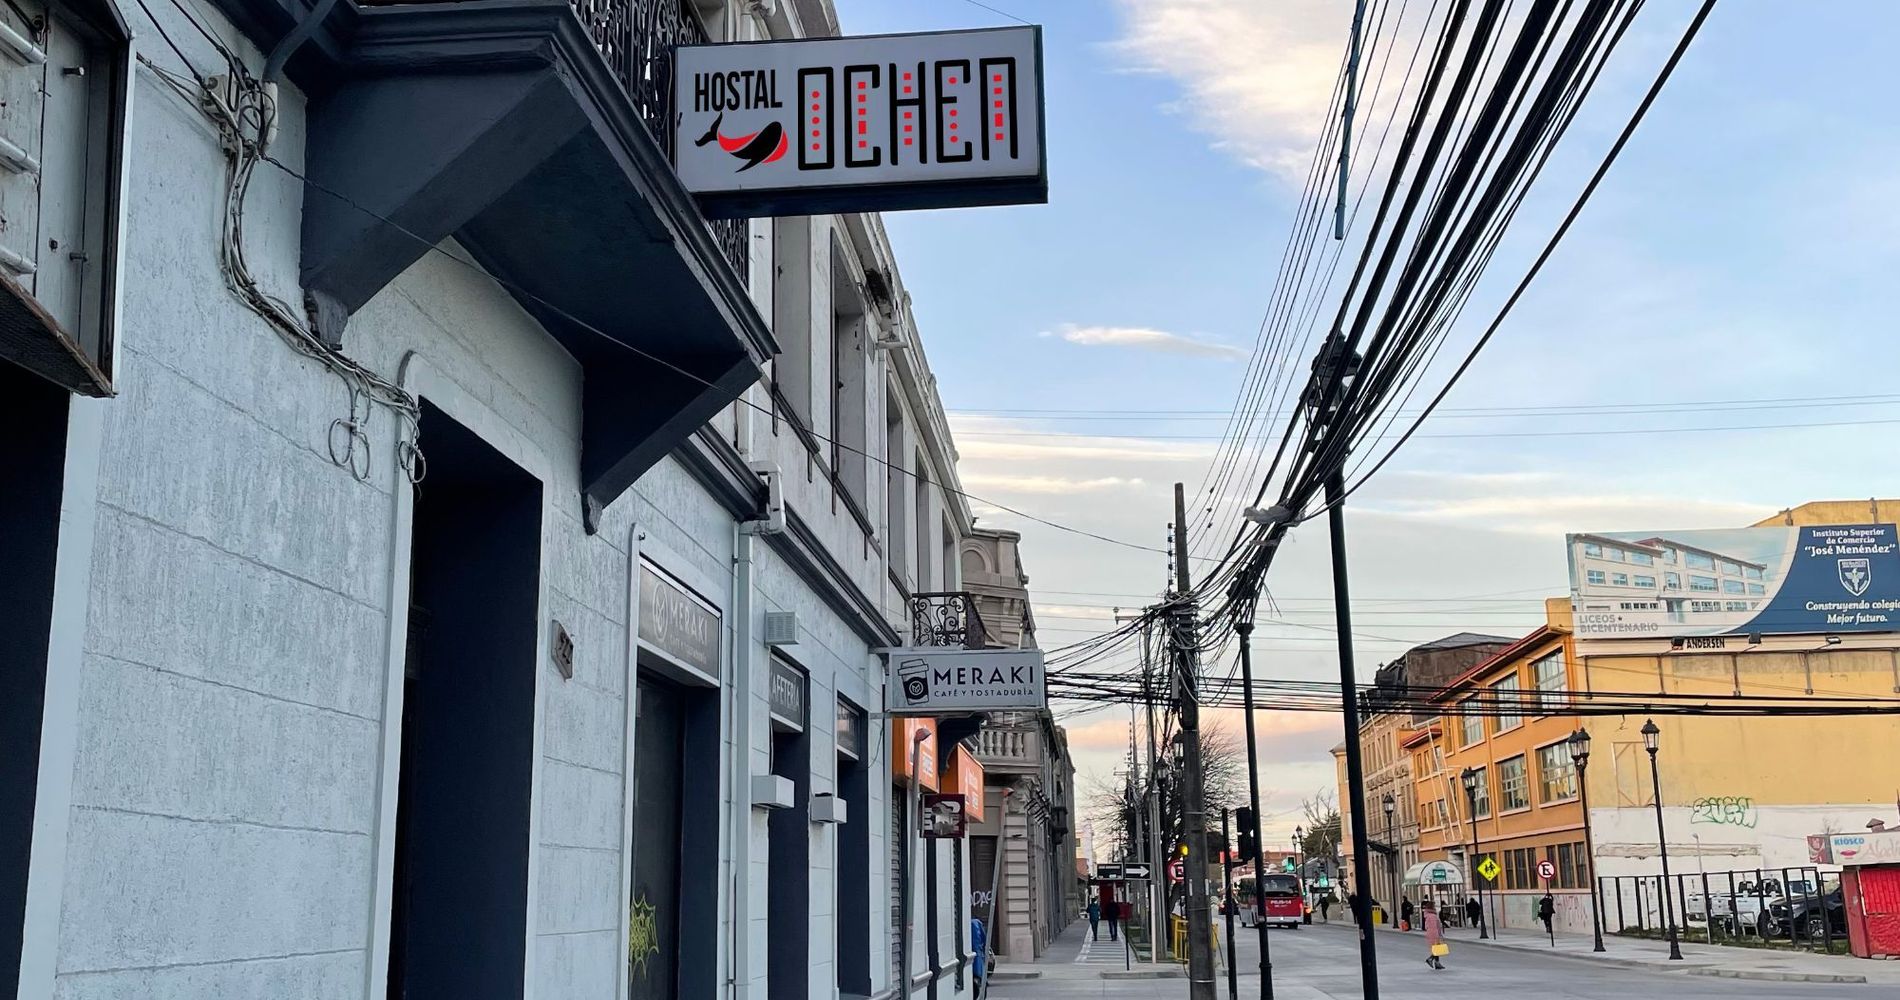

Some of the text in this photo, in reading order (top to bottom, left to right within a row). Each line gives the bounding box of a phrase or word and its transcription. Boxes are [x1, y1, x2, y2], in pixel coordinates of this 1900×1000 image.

[694, 69, 783, 113] HOSTAL
[1812, 528, 1885, 538] Instituto Superior
[1826, 536, 1876, 545] de Comercio
[1805, 600, 1871, 613] Construyendo
[670, 597, 708, 646] MERAKI
[1579, 615, 1616, 624] LICEOS
[1827, 612, 1889, 626] Mejor futuro.
[1580, 622, 1659, 633] BICENTENARIO
[1686, 638, 1726, 649] ANDERSEN
[933, 666, 1034, 686] MERAKI
[934, 686, 1034, 698] CAFÉ Y TOSTADURÍA
